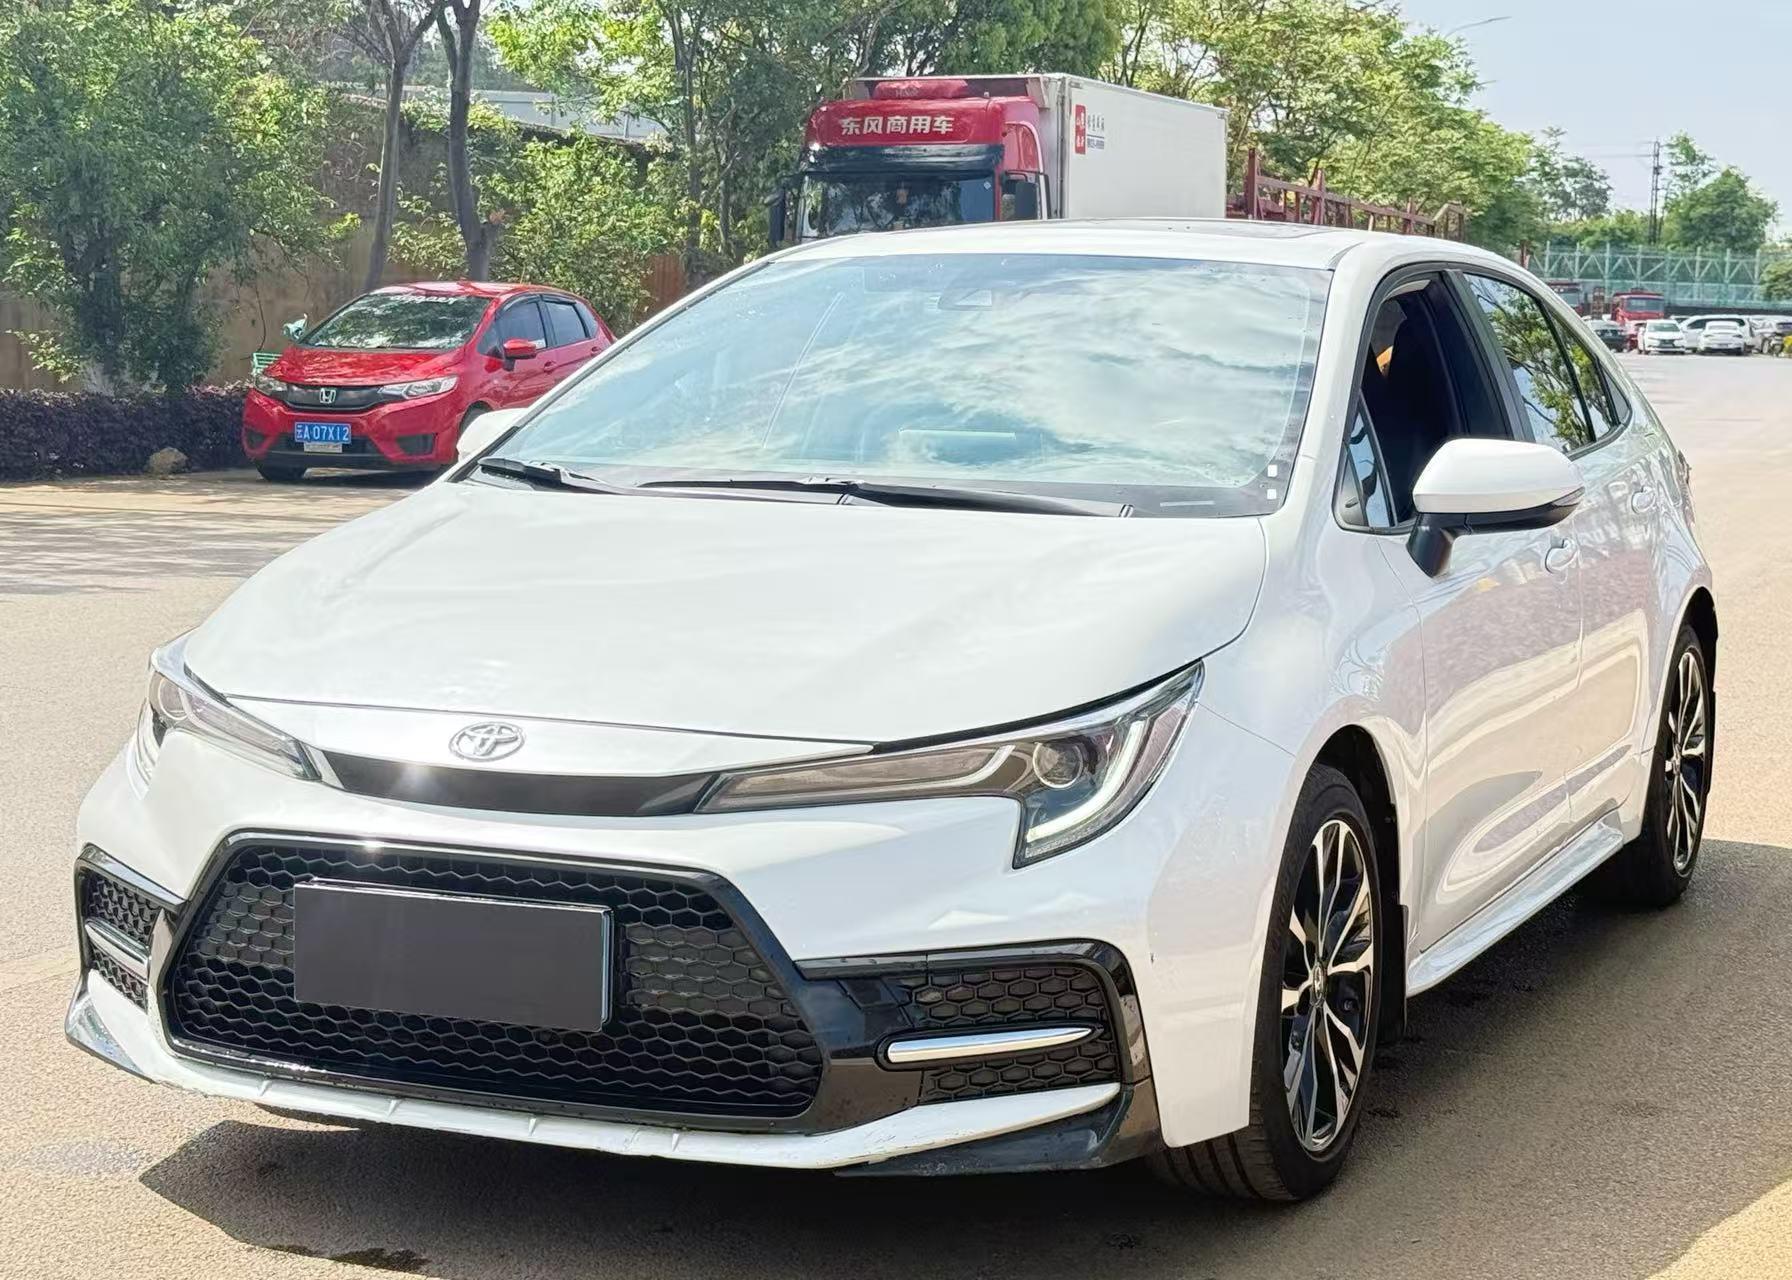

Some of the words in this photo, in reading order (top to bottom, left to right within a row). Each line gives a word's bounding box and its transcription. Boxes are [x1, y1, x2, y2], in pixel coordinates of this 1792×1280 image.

[840, 116, 955, 135] 东风商用车
